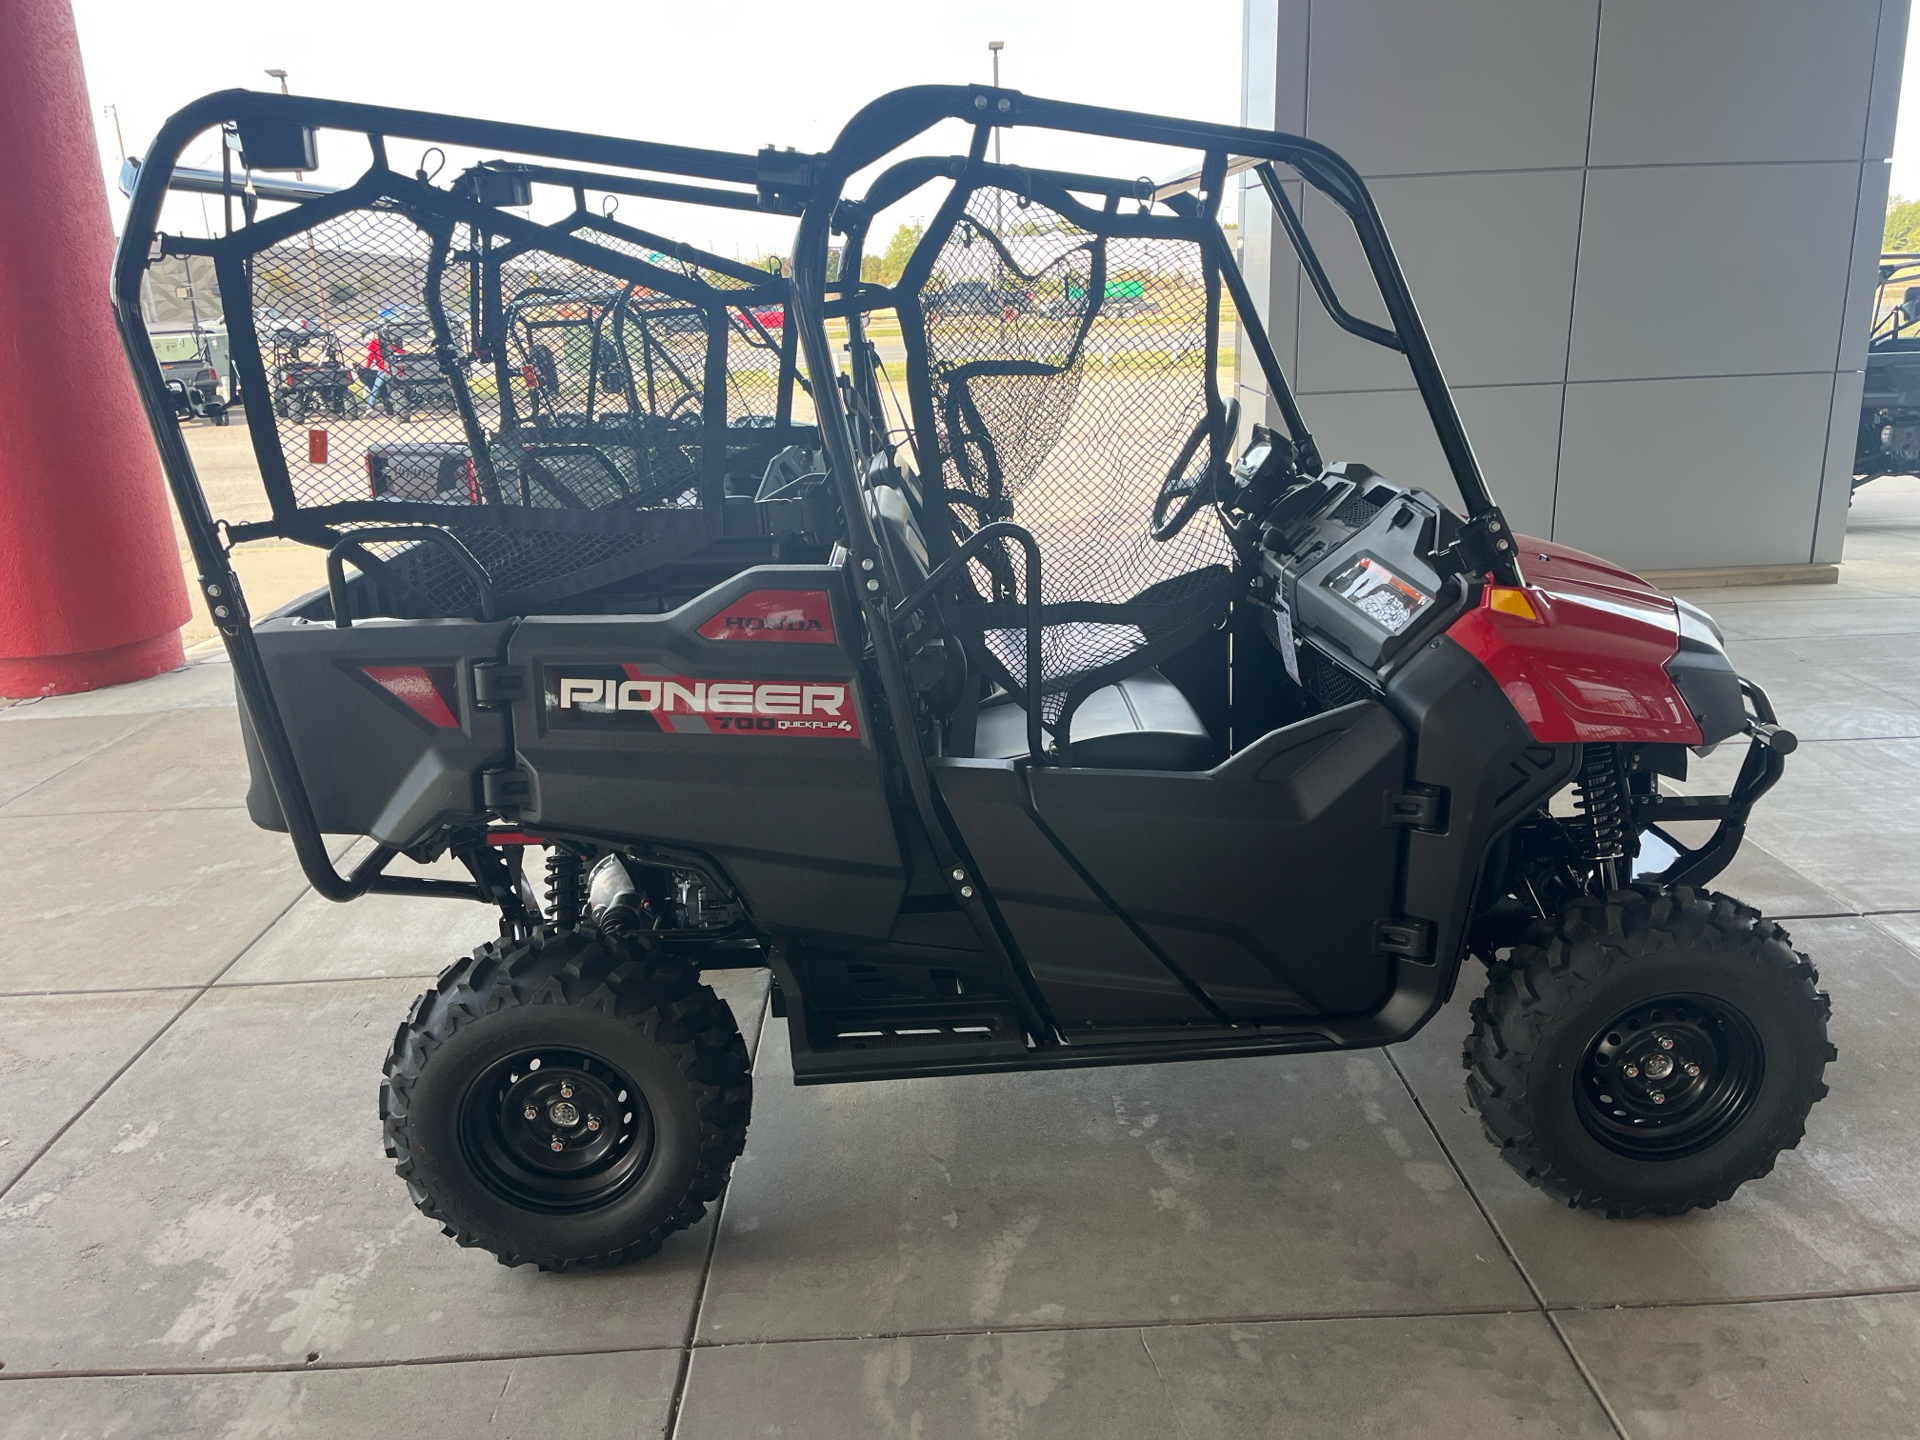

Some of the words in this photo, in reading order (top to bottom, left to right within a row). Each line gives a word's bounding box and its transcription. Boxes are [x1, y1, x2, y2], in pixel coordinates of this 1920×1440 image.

[724, 616, 826, 632] HONDA
[560, 678, 845, 716] PIONEER
[713, 717, 776, 730] 700
